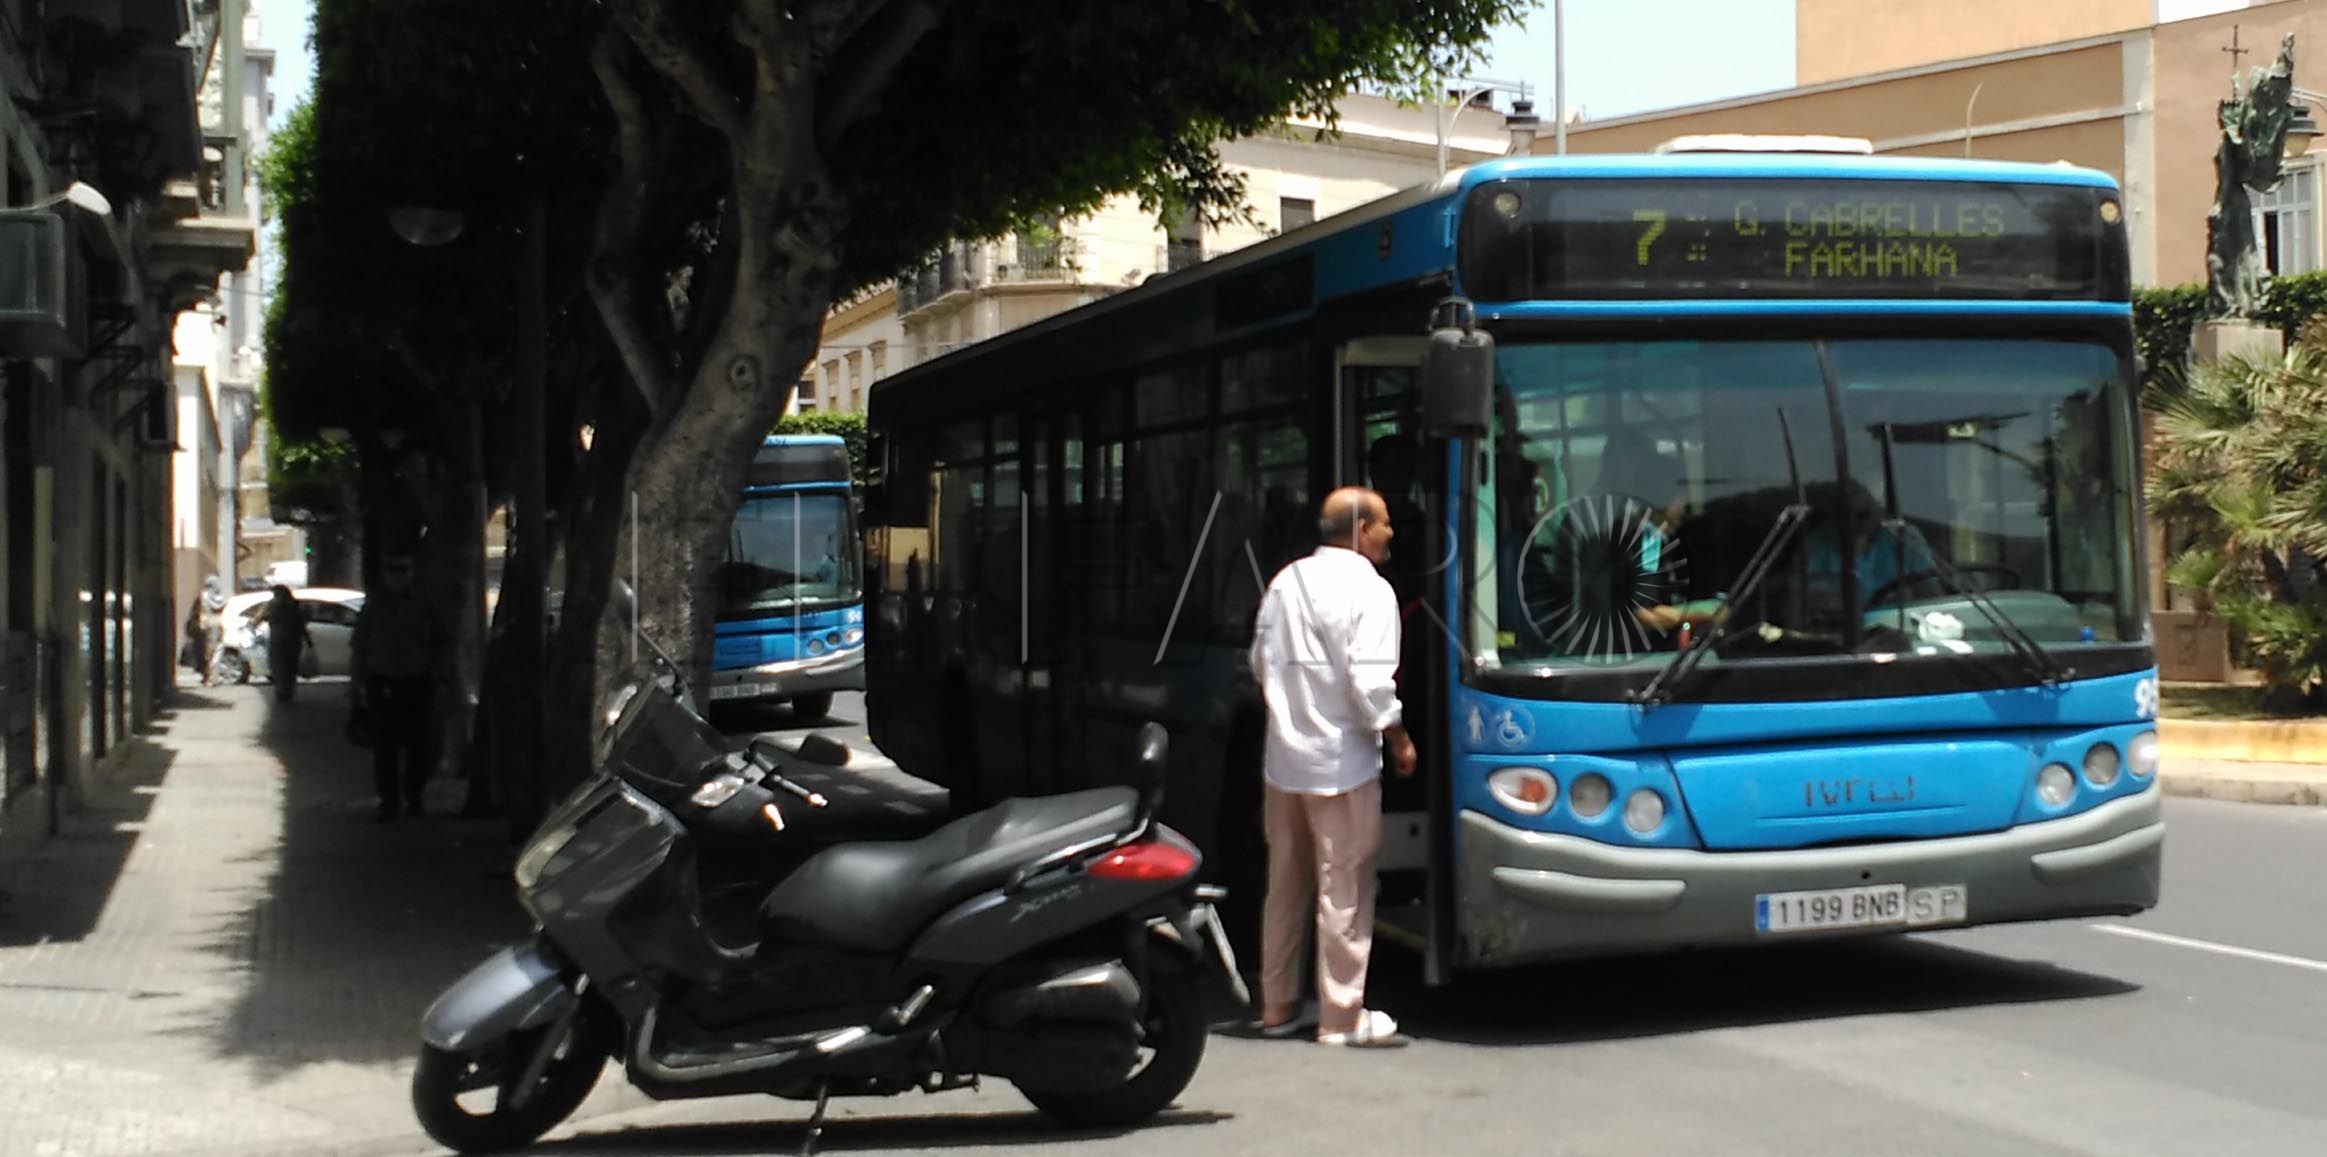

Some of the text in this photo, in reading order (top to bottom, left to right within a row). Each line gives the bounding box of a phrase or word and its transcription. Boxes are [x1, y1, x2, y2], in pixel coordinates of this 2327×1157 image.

[1632, 208, 1666, 266] 7
[1734, 202, 2005, 238] G. CABRELLES
[1784, 243, 1959, 277] FARHANA
[1778, 891, 1899, 924] 1199 BNB
